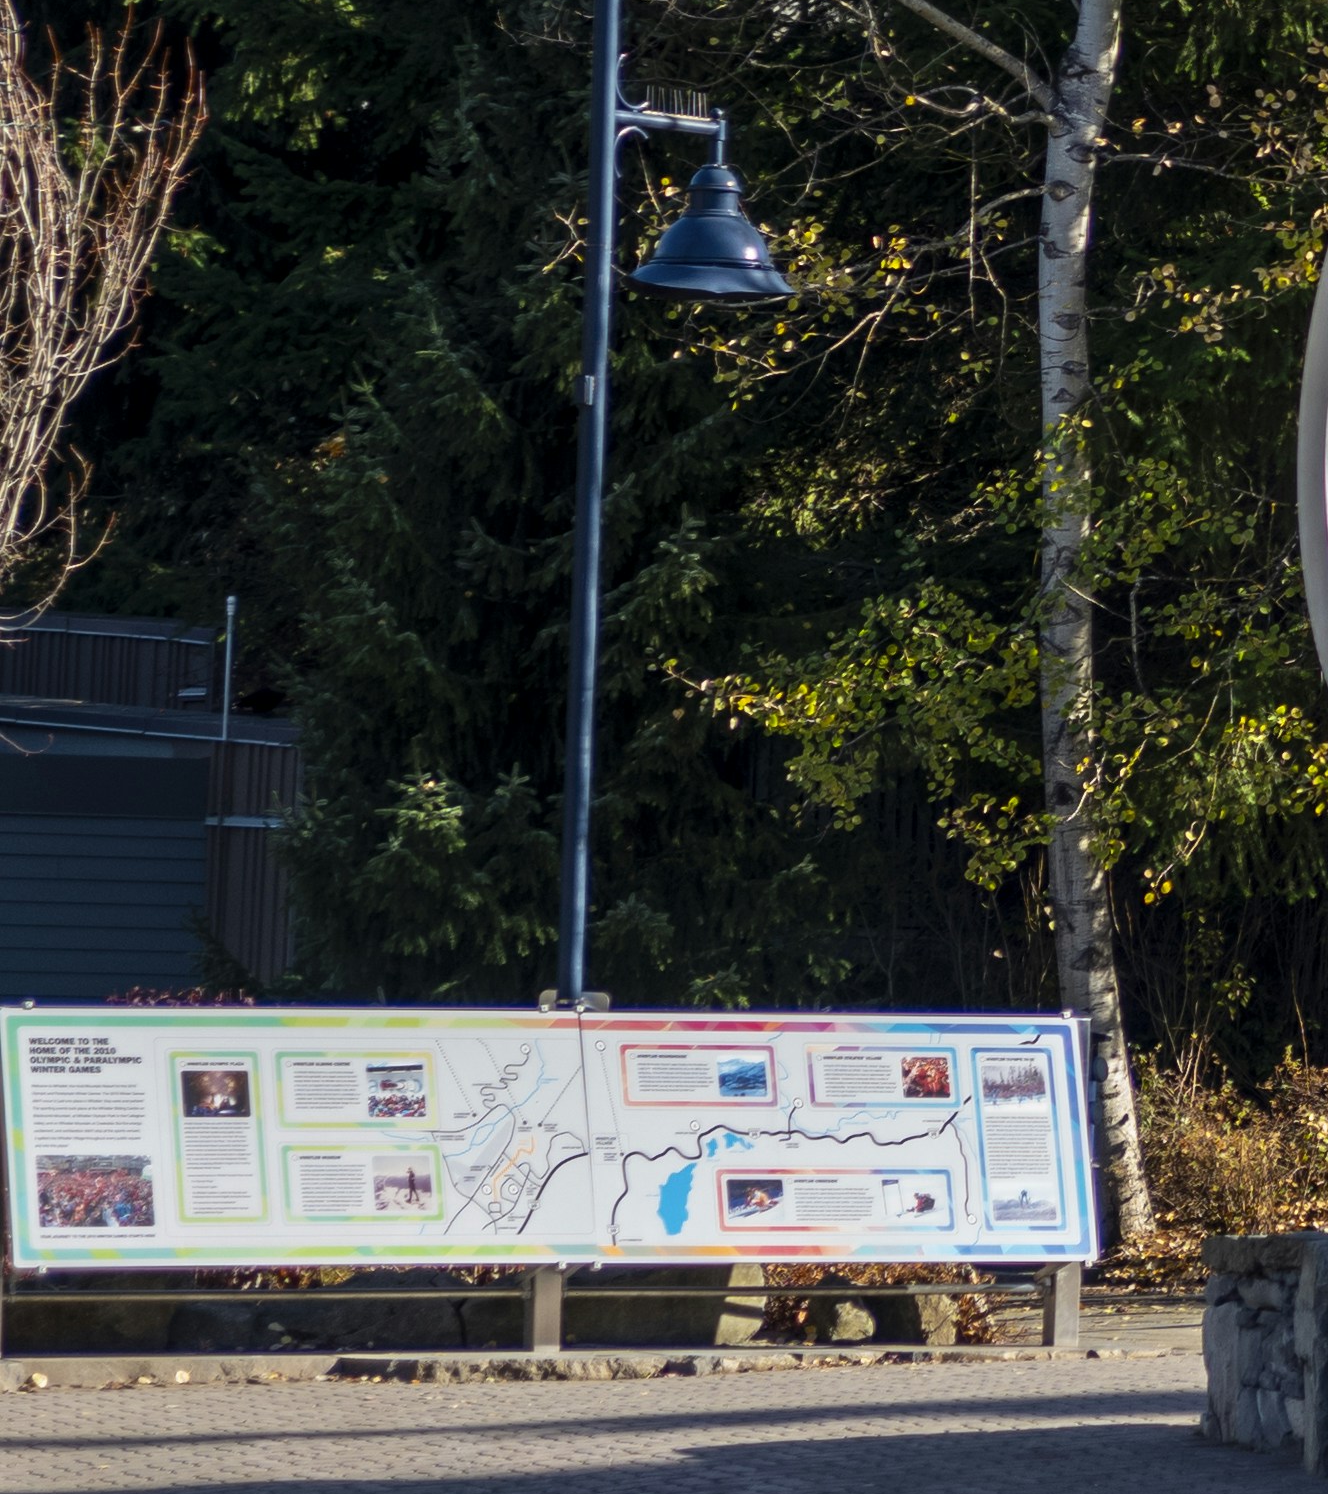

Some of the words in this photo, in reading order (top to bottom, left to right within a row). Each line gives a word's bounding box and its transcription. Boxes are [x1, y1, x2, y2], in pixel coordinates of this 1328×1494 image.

[29, 1037, 75, 1045] WELCOME
[78, 1037, 89, 1045] TO
[92, 1037, 109, 1045] THE
[29, 1047, 57, 1055] HOME
[59, 1047, 71, 1055] OF
[74, 1047, 91, 1055] THE
[94, 1047, 116, 1055] 2010
[30, 1056, 71, 1065] OLYMPIC
[73, 1056, 81, 1064] &
[84, 1056, 142, 1065] PARALYMPIC
[30, 1066, 66, 1074] WINTER
[68, 1066, 102, 1074] GAMES
